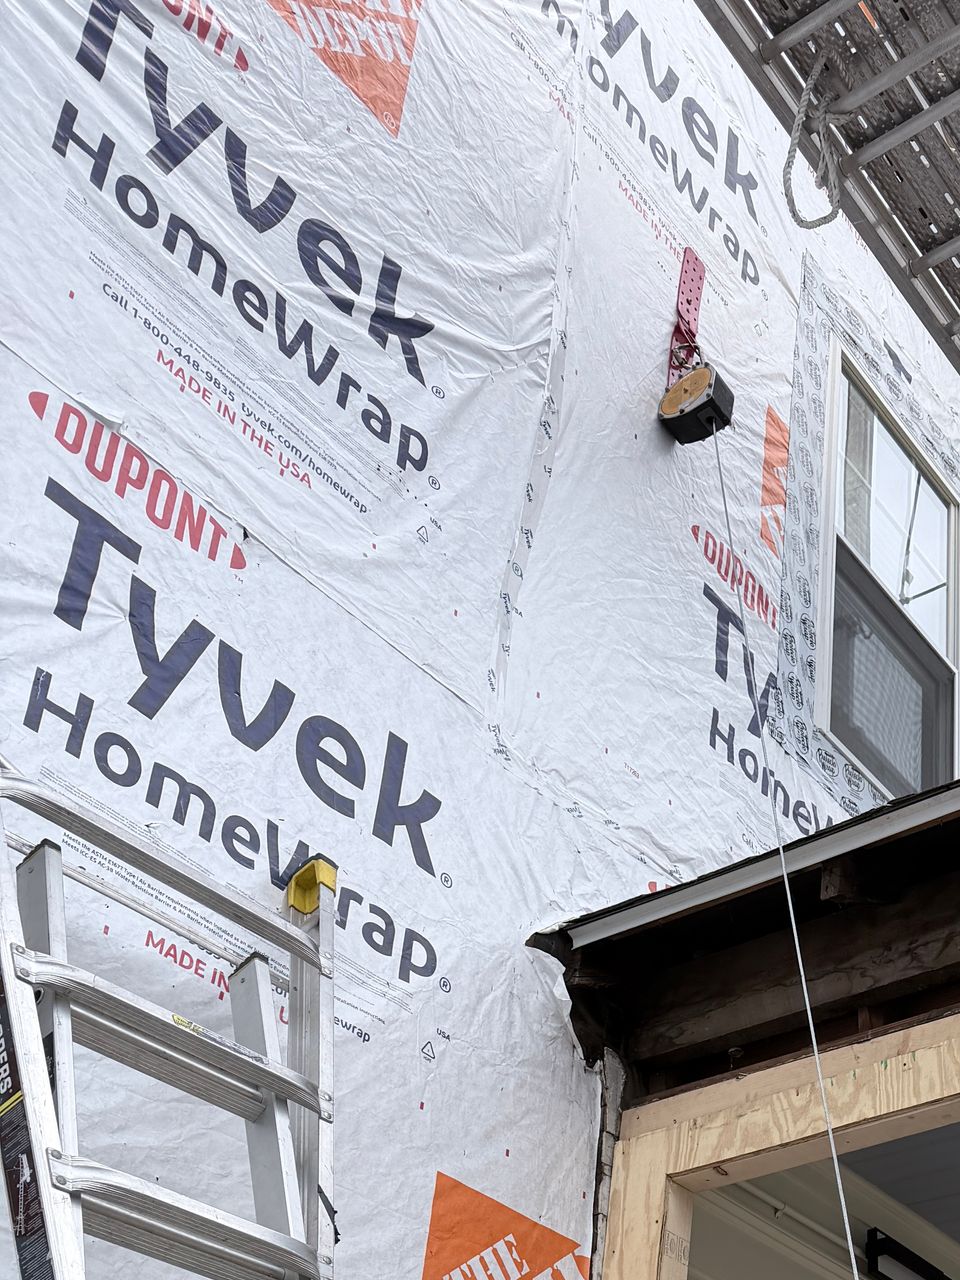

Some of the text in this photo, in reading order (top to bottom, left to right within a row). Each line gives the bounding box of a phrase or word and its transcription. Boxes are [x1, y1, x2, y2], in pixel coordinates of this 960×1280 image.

[588, 54, 760, 288] omeWrap
[600, 0, 760, 227] yvek
[55, 402, 229, 564] DUPONT
[102, 283, 129, 311] Call
[132, 308, 236, 402] 1-800-448-9835
[241, 402, 367, 514] tyvek.com/homewrap
[156, 349, 312, 489] MADE IN THE USA
[43, 476, 442, 878] Tyvek
[703, 530, 778, 630] DUPONT
[145, 930, 207, 979] MADE
[210, 967, 230, 993] IN
